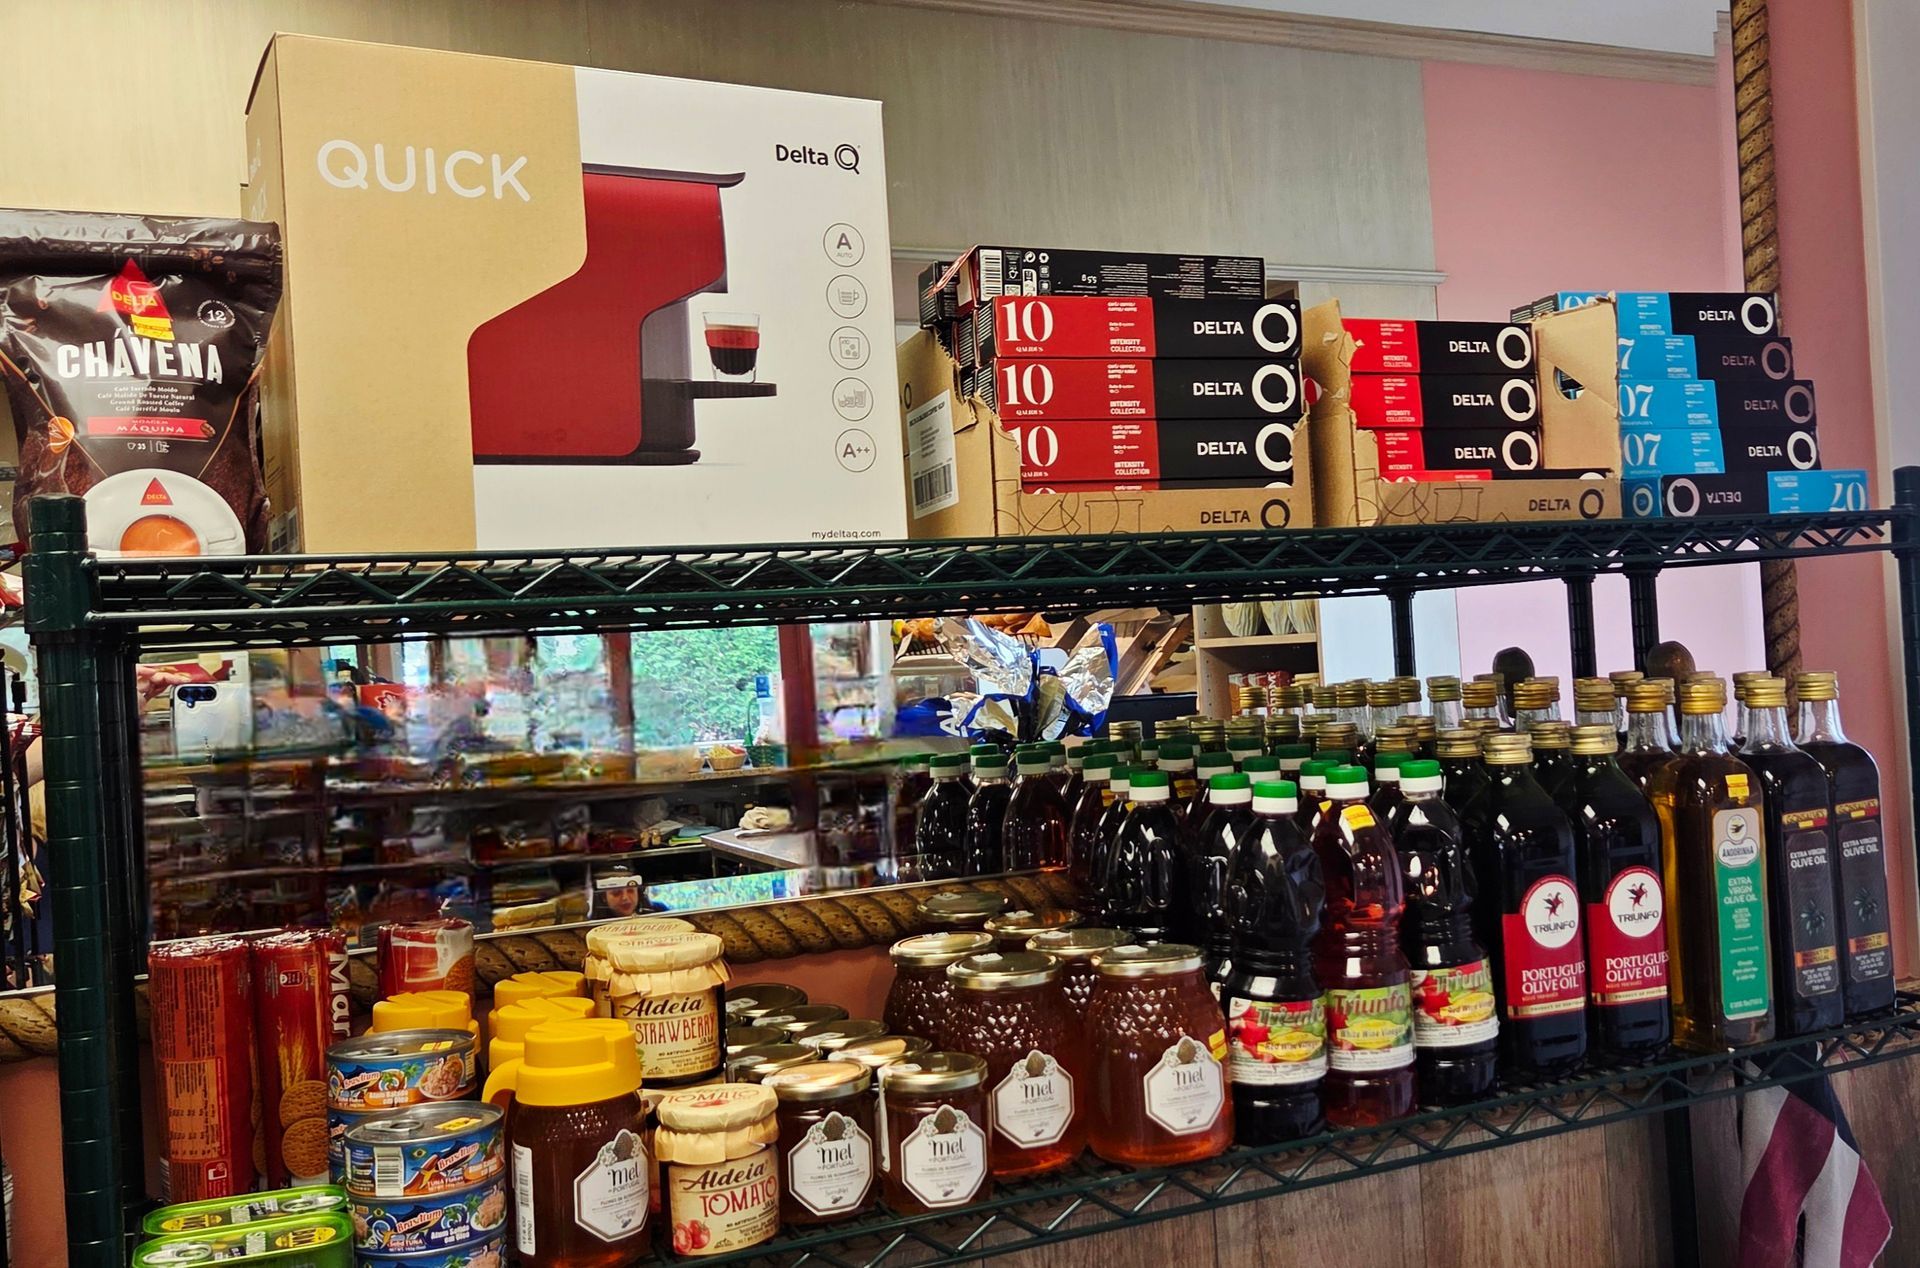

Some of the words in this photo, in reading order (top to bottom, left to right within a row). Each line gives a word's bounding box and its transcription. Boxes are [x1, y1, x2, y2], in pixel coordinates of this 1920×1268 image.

[317, 139, 531, 202] QUICK
[774, 143, 830, 167] Delta
[833, 142, 861, 175] Q
[836, 232, 852, 250] A
[111, 290, 158, 307] DELTA
[207, 309, 228, 323] 12
[1002, 300, 1054, 342] 10
[1193, 321, 1244, 335] DELTA
[1252, 303, 1298, 353] Q
[1698, 310, 1736, 321] DELTA
[1741, 296, 1774, 335] Q
[56, 327, 223, 385] CHÁVENA
[1449, 340, 1490, 353] DELTA
[1496, 326, 1532, 370] Q
[1618, 337, 1635, 370] 7
[1722, 355, 1756, 366] DELTA
[1761, 341, 1791, 380] Q
[1002, 364, 1054, 406] 10
[1192, 382, 1244, 396] DELTA
[1251, 363, 1297, 413] Q
[1453, 394, 1494, 406] DELTA
[1500, 378, 1536, 422] Q
[1618, 384, 1654, 418] 07
[1744, 400, 1779, 411] DELTA
[1784, 384, 1814, 424] Q
[116, 424, 184, 434] MÁQUINA
[842, 442, 870, 459] A++
[1197, 442, 1248, 456] DELTA
[1255, 423, 1293, 472] Q
[1455, 447, 1496, 459] DELTA
[1502, 430, 1539, 471] Q
[1623, 432, 1662, 467] 07
[1748, 446, 1783, 457] DELTA
[1787, 430, 1817, 470] Q
[1115, 468, 1150, 476] COLLECTION
[1528, 499, 1571, 512] DELTA
[1579, 488, 1604, 520] Q
[1705, 491, 1742, 503] DELTA
[1829, 482, 1866, 515] 07
[1200, 510, 1251, 524] DELTA
[1260, 498, 1291, 529] Q
[811, 528, 882, 540] mydeltaq.com
[1722, 846, 1754, 858] ANDORINHA
[1790, 851, 1808, 859] EXTRA
[1807, 848, 1827, 856] VIRGIN
[1843, 840, 1860, 848] EXTRA
[1859, 836, 1878, 845] VIRGIN
[1843, 845, 1866, 857] OLIVE
[1865, 844, 1879, 853] OIL
[1790, 857, 1814, 868] OLIVE
[1813, 855, 1828, 865] OIL
[1727, 876, 1752, 887] EXTRA
[1727, 885, 1753, 896] VIRGIN
[1723, 895, 1745, 905] OLIVE
[1745, 893, 1759, 902] OIL
[1533, 920, 1576, 934] TRIUNFO
[1618, 910, 1660, 923] TRIUNFO
[1522, 978, 1559, 995] OLIVE
[1560, 975, 1579, 990] OIL
[1606, 967, 1642, 983] OLIVE
[1643, 965, 1662, 978] OIL
[329, 953, 350, 1037] Mar
[619, 996, 705, 1017] Aldeia
[1333, 990, 1405, 1014] Triunfo
[635, 1011, 716, 1045] STRAWBERRY
[668, 1088, 760, 1103] TOMATO
[437, 1142, 480, 1171] BrasAtum
[822, 1160, 854, 1170] PORTUGAL
[612, 1180, 640, 1193] PORTUGAL
[679, 1162, 765, 1191] Aldeia
[699, 1175, 778, 1218] TOMATO
[397, 1209, 443, 1233] BrasAtum
